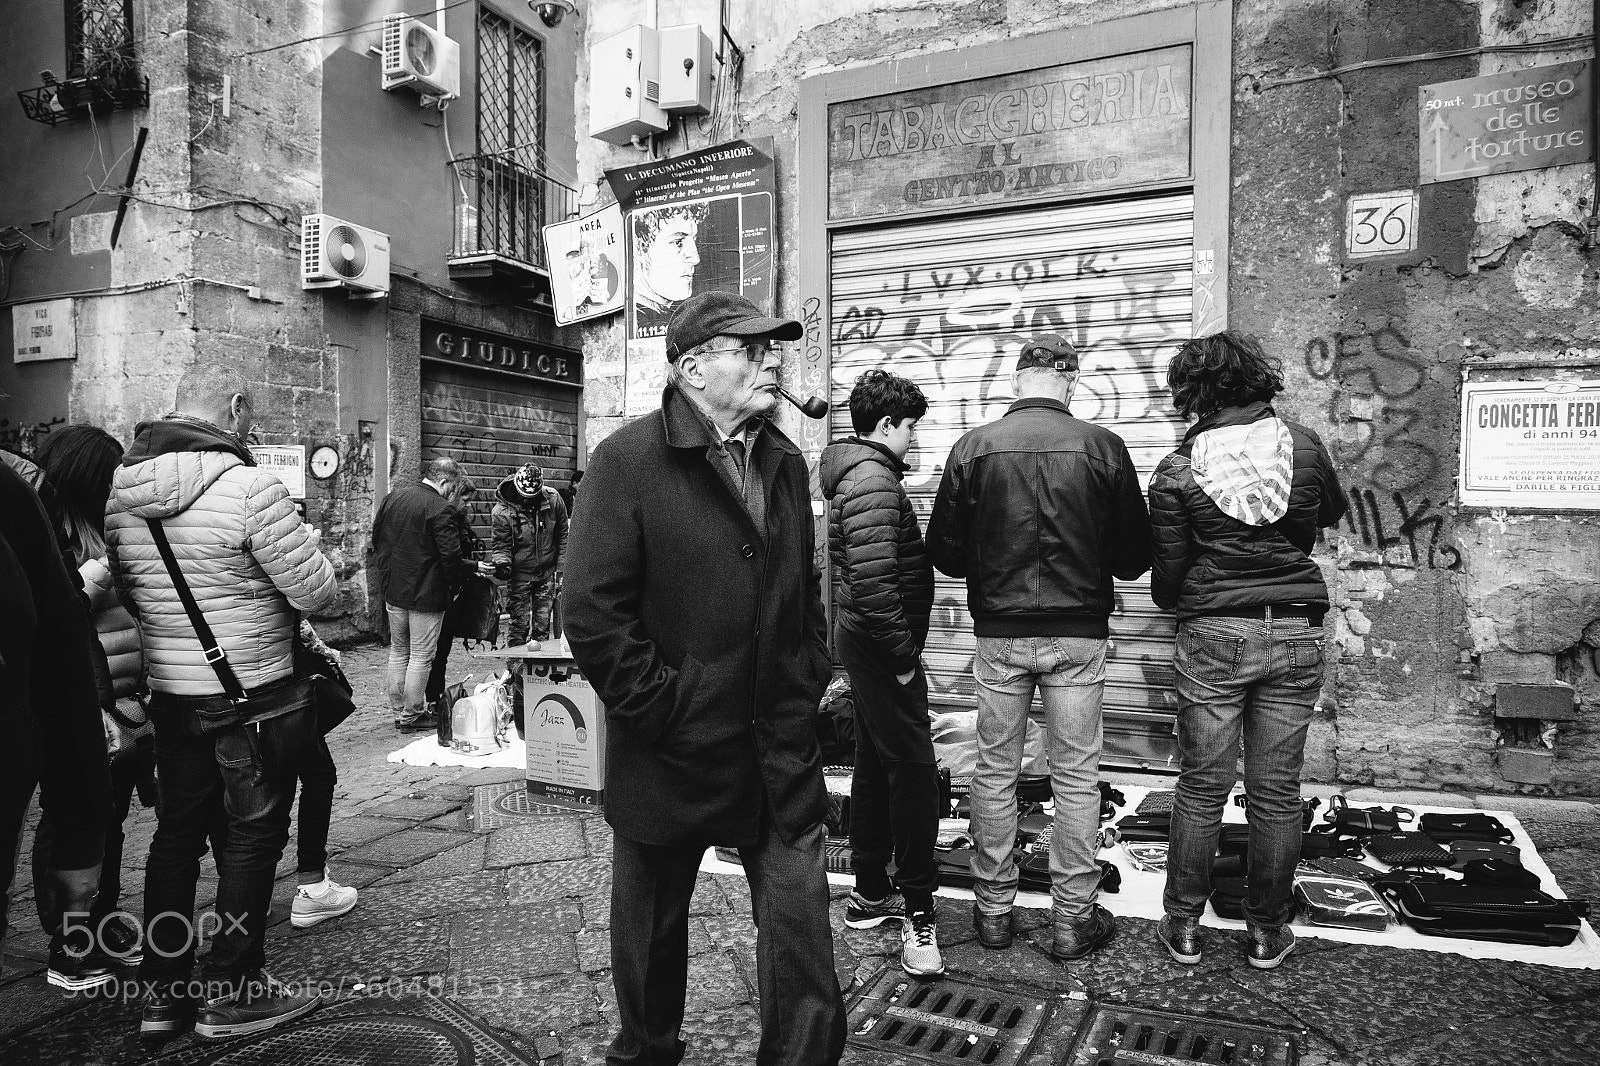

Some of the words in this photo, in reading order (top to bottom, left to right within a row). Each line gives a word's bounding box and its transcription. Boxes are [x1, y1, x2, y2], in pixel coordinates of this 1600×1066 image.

[1425, 98, 1443, 111] 50
[1485, 103, 1561, 132] delle
[976, 142, 1022, 170] AL
[1465, 129, 1585, 163] torture
[624, 173, 636, 181] IL
[638, 158, 697, 179] DECUMANO
[700, 146, 754, 164] INFERIORE
[580, 218, 602, 234] AREA
[1353, 202, 1410, 246] 36
[436, 332, 569, 377] GIUDICE
[1478, 403, 1559, 428] CONCETTA
[1523, 429, 1536, 439] di
[1542, 429, 1574, 439] anni
[1579, 429, 1598, 439] 94
[540, 708, 565, 727] Jazz
